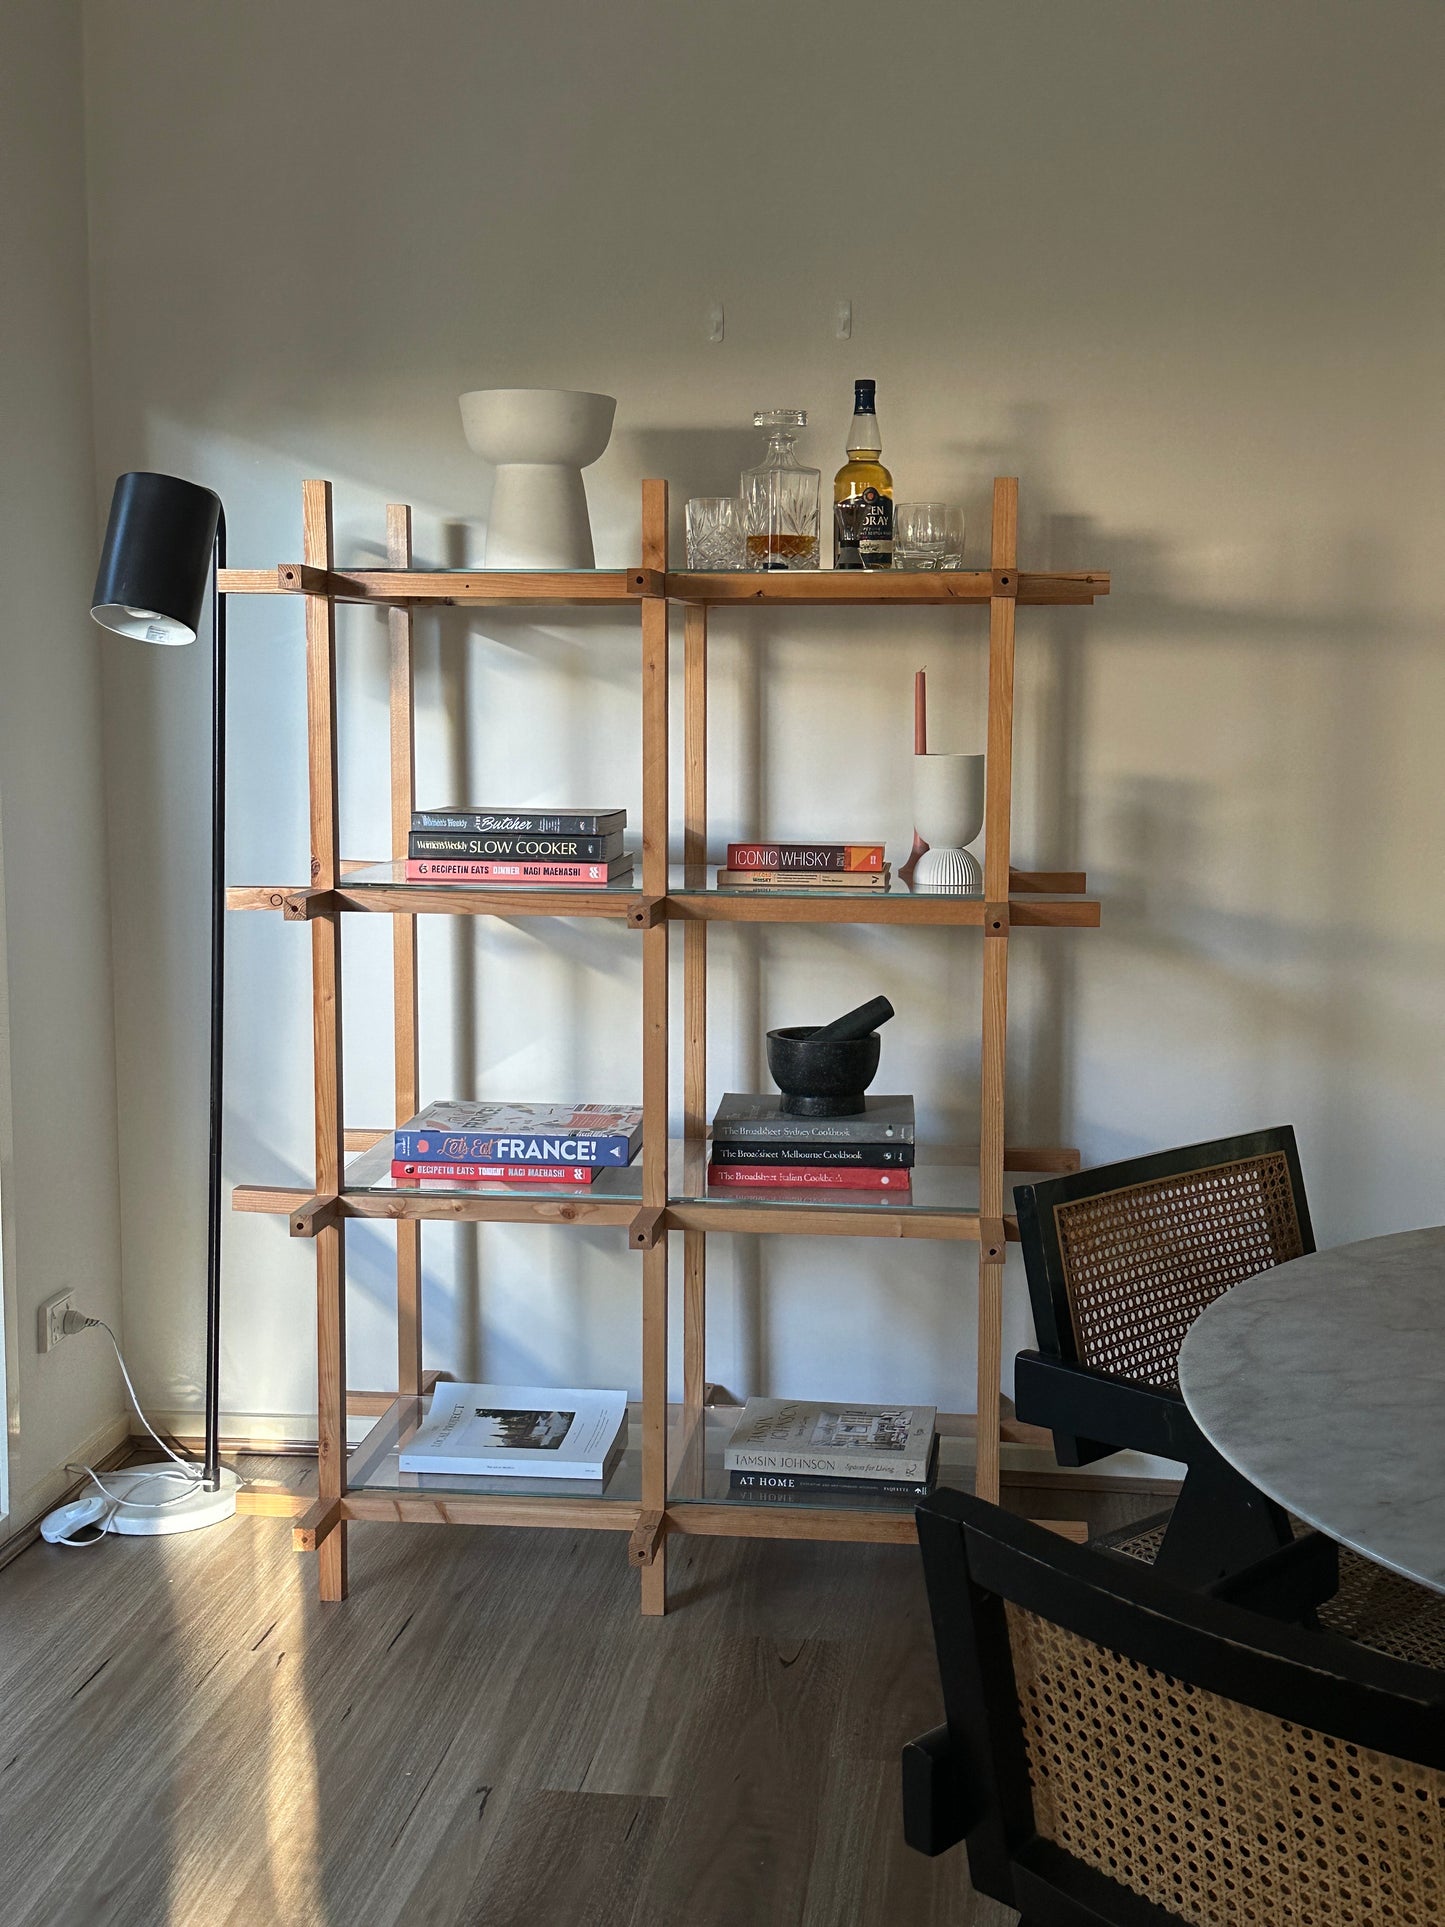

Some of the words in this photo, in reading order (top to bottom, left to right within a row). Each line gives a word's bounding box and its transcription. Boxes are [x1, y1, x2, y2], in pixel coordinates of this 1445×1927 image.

[476, 816, 533, 832] Butcher
[470, 841, 513, 853] SLOW
[516, 842, 578, 855] COOKER
[735, 850, 778, 866] ICONIC
[780, 851, 831, 867] WHISKY
[432, 865, 468, 873] RECIPETIN
[471, 866, 489, 874] EATS
[524, 867, 540, 875] NAGI
[722, 1127, 739, 1135] The
[740, 1127, 780, 1136] Broadsheet
[784, 1127, 809, 1137] Sydney
[812, 1127, 850, 1137] Cookbook
[470, 1138, 499, 1159] Eat
[497, 1139, 597, 1160] FRANCE!
[721, 1149, 737, 1157] The
[738, 1149, 779, 1158] Broadsheet
[782, 1150, 822, 1159] Melbourne
[823, 1150, 862, 1159] Cookbook
[457, 1166, 474, 1174] EATS
[719, 1171, 734, 1180] The
[736, 1172, 776, 1181] Broadsheet
[735, 1455, 776, 1467] TAMSIN
[780, 1457, 836, 1470] JOHNSON
[740, 1476, 755, 1485] AT
[760, 1477, 795, 1487] HOME
